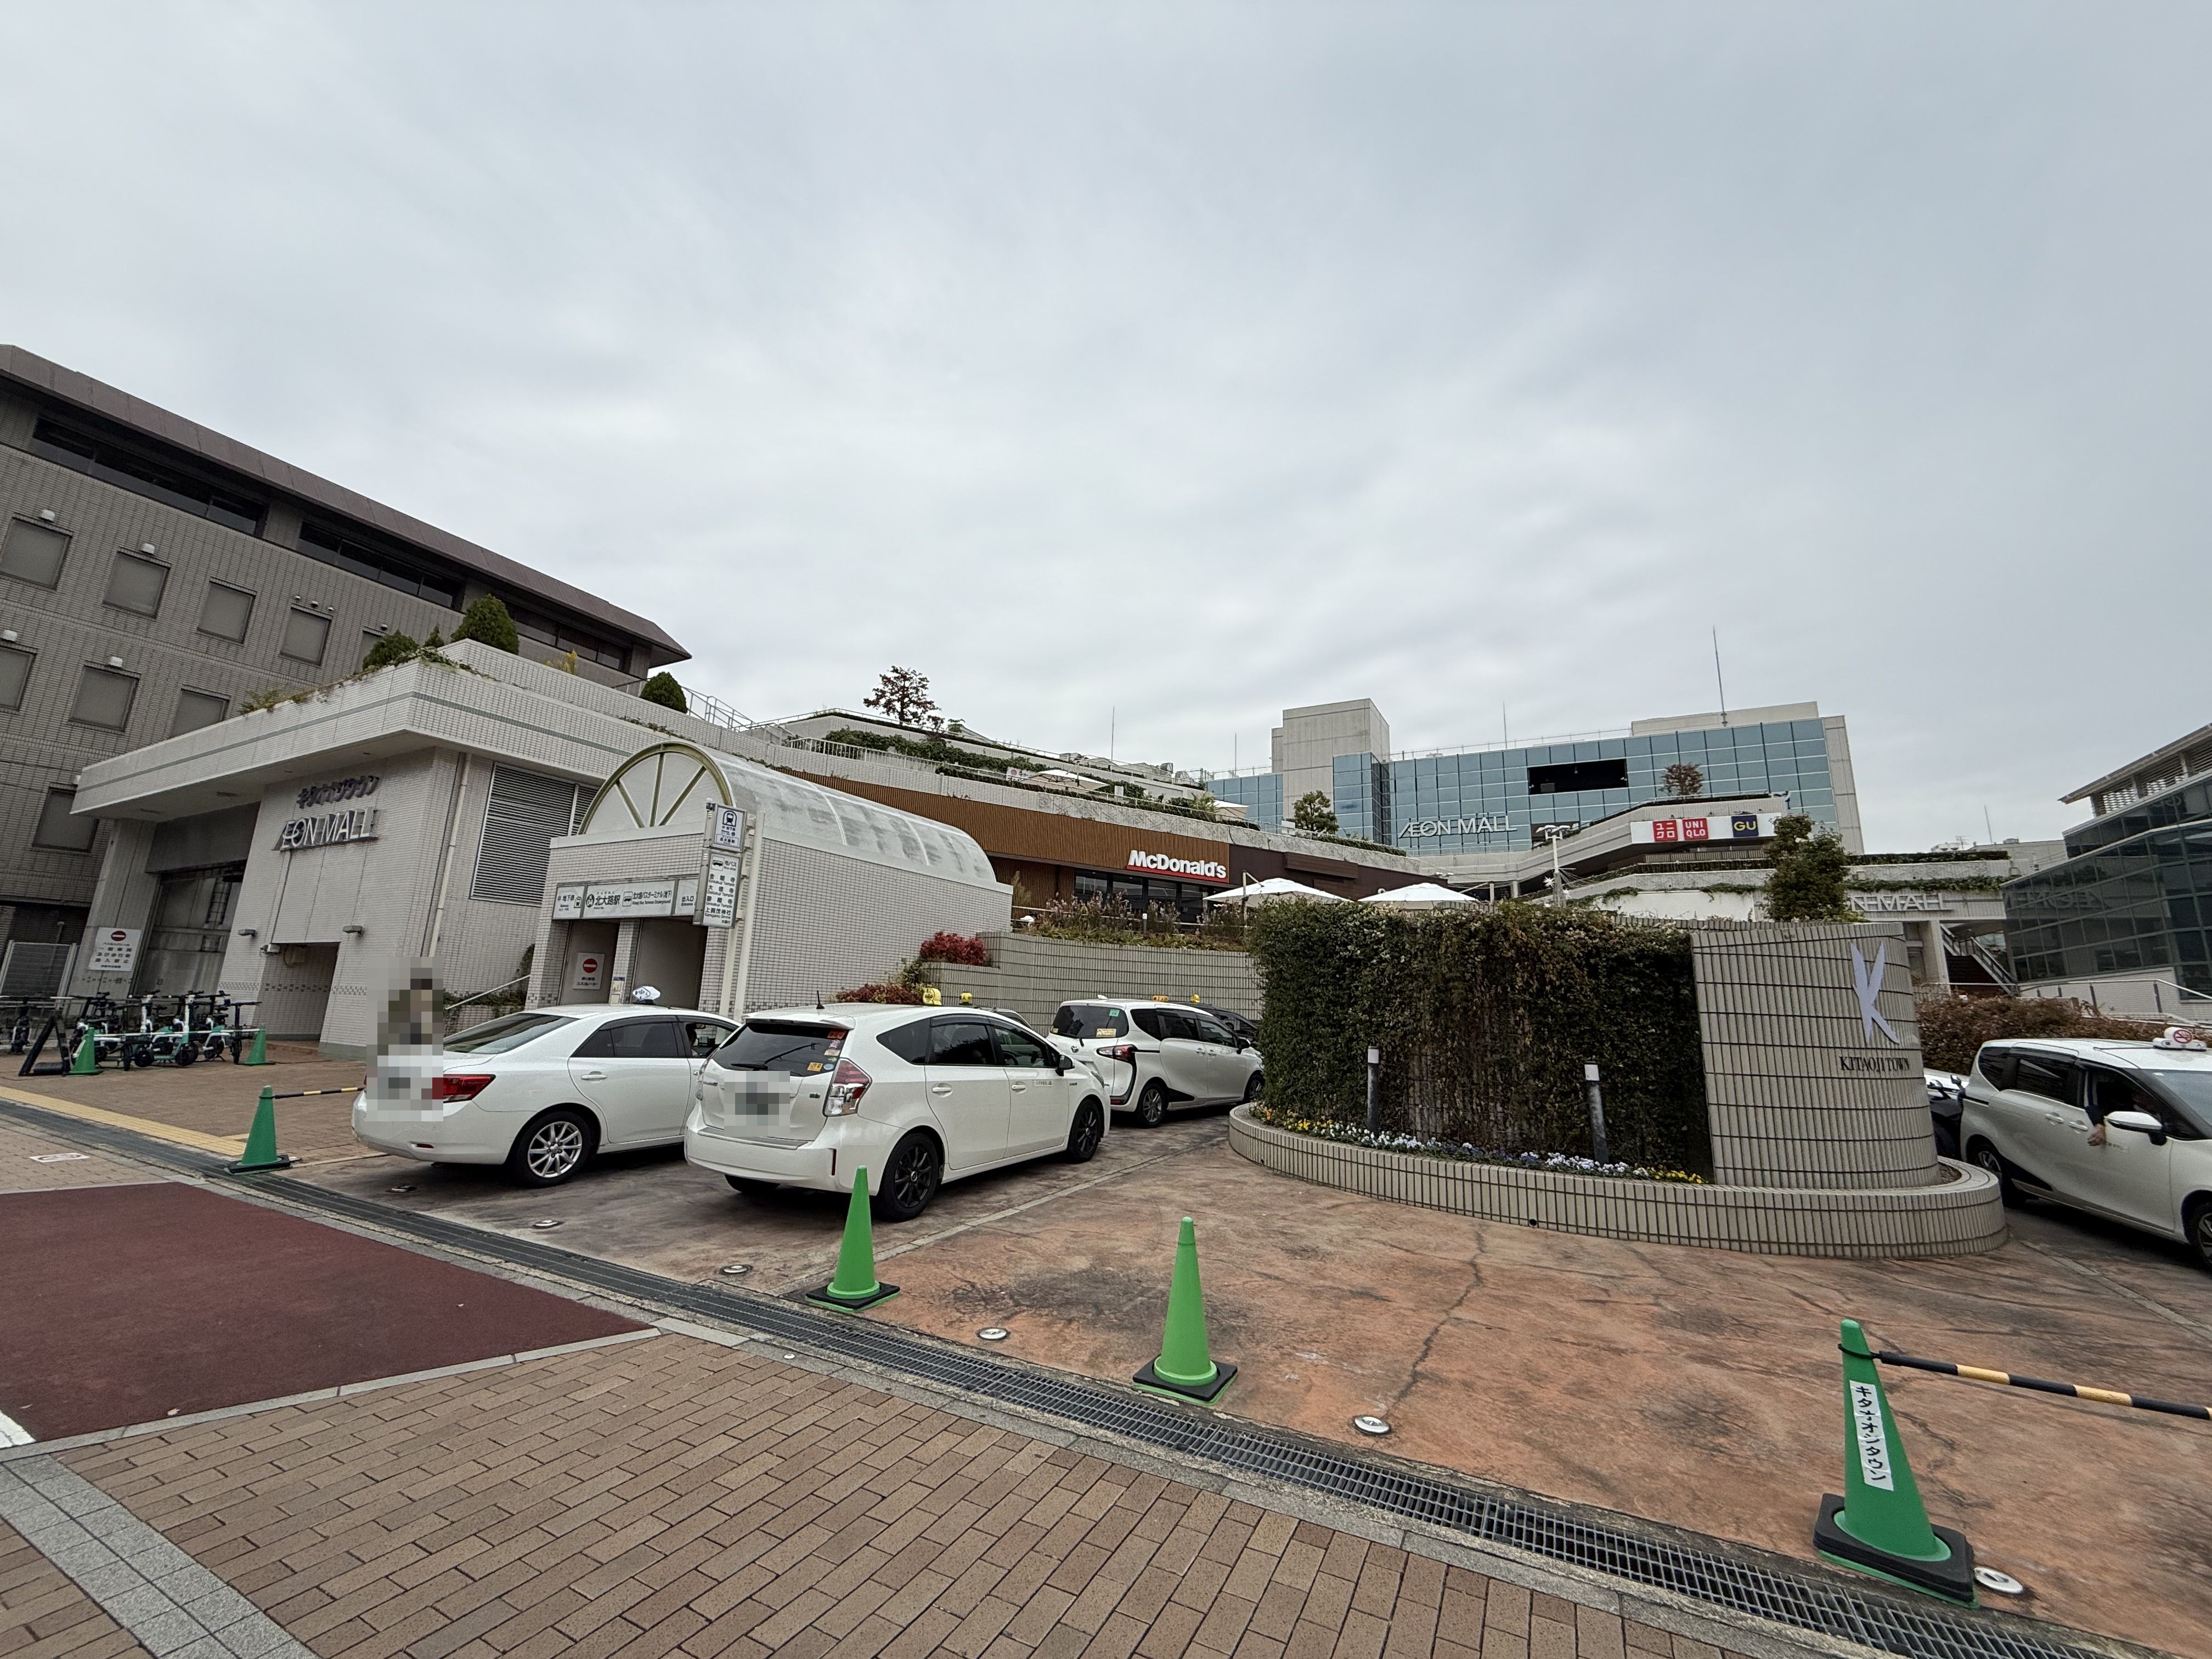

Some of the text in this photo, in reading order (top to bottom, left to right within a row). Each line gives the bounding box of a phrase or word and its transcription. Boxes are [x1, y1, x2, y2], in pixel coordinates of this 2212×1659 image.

[320, 808, 372, 845] MALL
[1458, 815, 1517, 833] MALL
[1734, 821, 1756, 831] GU
[1128, 850, 1227, 878] McDonald's
[595, 895, 620, 906] 北大路駅
[1877, 893, 1953, 911] MALL
[1839, 1057, 1910, 1073] KITAOJI TOWN
[1855, 1386, 1887, 1481] キタオオジタウン
